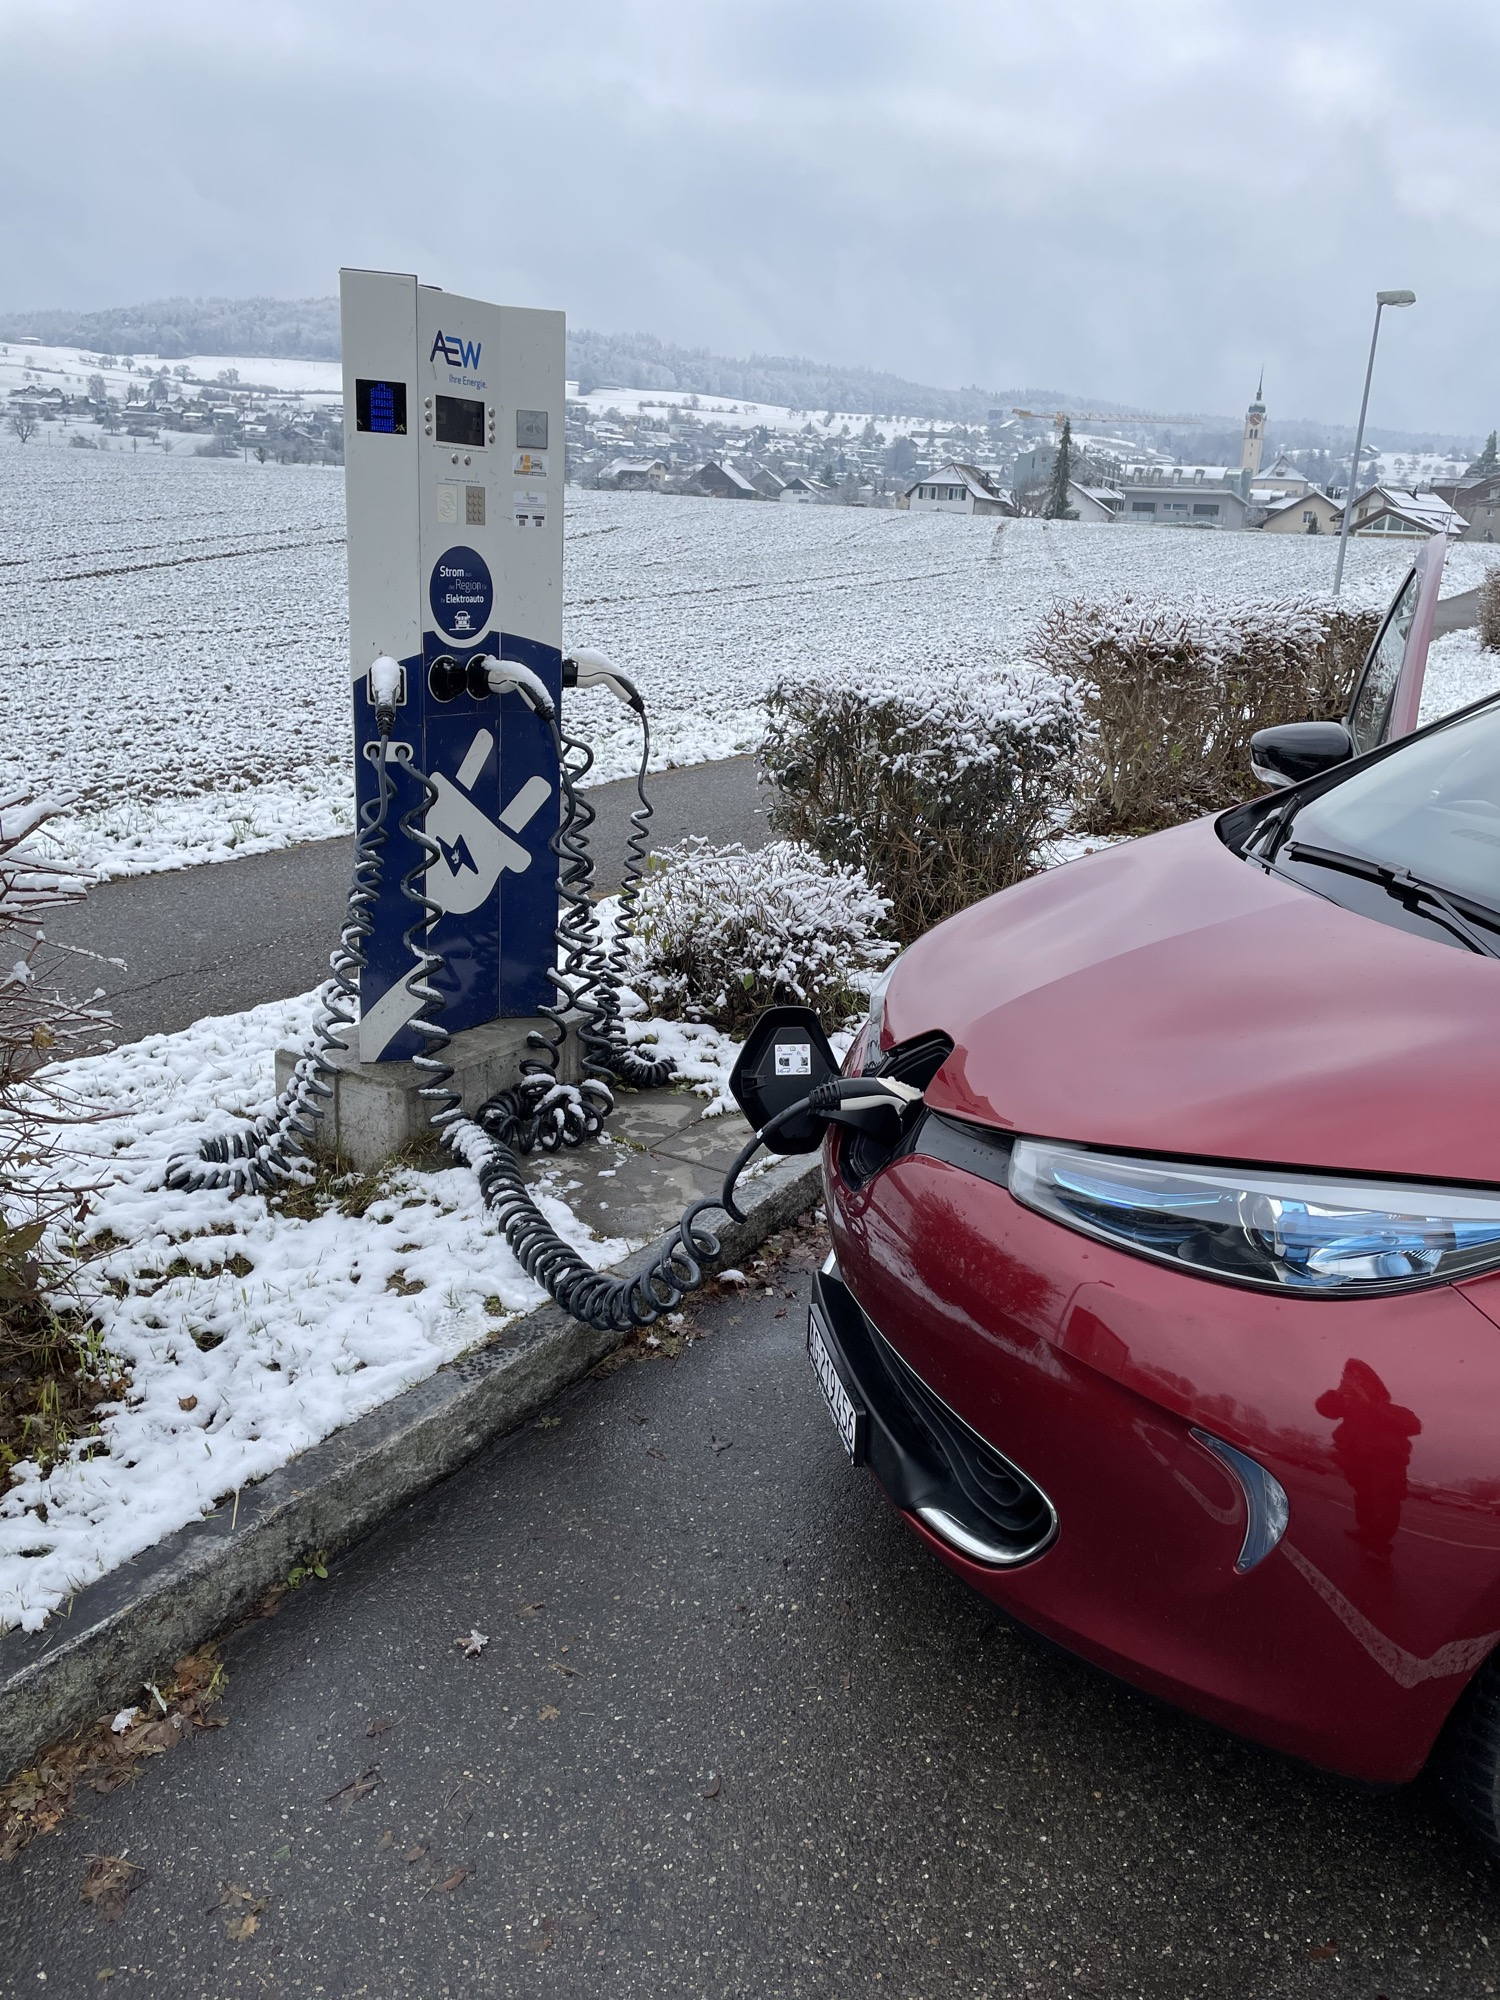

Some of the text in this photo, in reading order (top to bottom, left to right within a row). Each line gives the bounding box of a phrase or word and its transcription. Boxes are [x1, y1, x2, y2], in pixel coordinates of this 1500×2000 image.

[430, 330, 482, 370] AEW
[448, 373, 462, 385] Ihre
[439, 565, 465, 577] Strom
[455, 579, 481, 593] Region
[446, 593, 485, 604] Elektroauto
